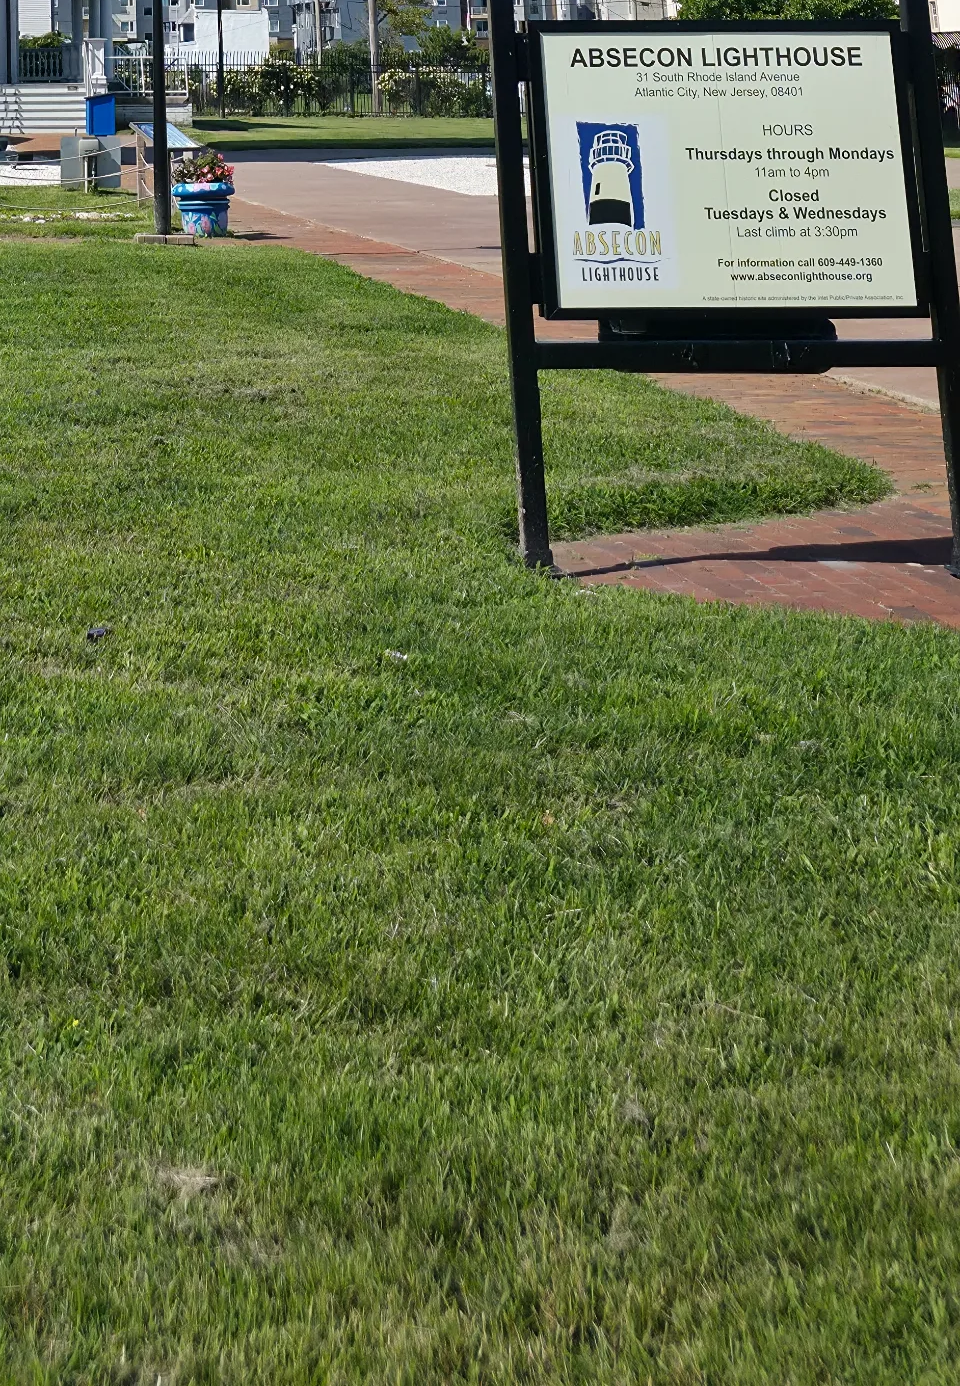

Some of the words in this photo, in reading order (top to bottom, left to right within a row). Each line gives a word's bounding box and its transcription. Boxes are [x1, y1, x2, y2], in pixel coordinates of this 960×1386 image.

[570, 47, 693, 68] ABSECON
[701, 46, 863, 67] LIGHTHOUSE
[636, 72, 649, 82] 31
[652, 72, 684, 82] South
[687, 71, 722, 82] Rhode
[725, 71, 757, 82] Island
[759, 71, 800, 82] Avenue
[634, 86, 674, 97] Atlantic
[677, 86, 700, 100] City,
[703, 86, 727, 97] New
[730, 86, 768, 100] Jersey,
[770, 86, 804, 97] 08401
[762, 124, 814, 136] HOURS
[685, 147, 763, 163] Thursdays
[767, 147, 824, 163] through
[828, 147, 895, 163] Mondays
[754, 167, 786, 178] 11am
[789, 166, 801, 178] to
[803, 167, 830, 180] 4pm
[768, 188, 820, 202] Closed
[704, 206, 774, 222] Tuesdays
[778, 206, 790, 220] &
[793, 206, 887, 222] Wednesdays
[736, 226, 762, 238] Last
[765, 225, 796, 238] climb
[799, 226, 812, 237] at
[814, 225, 858, 240] 3:30pm
[572, 230, 662, 256] ABSECON
[717, 258, 735, 268] For
[737, 258, 795, 268] information
[797, 257, 815, 267] call
[817, 257, 883, 268] 609-449-1360
[581, 266, 660, 282] LIGHTHOUSE
[730, 271, 873, 283] www.abseconlighthouse.org
